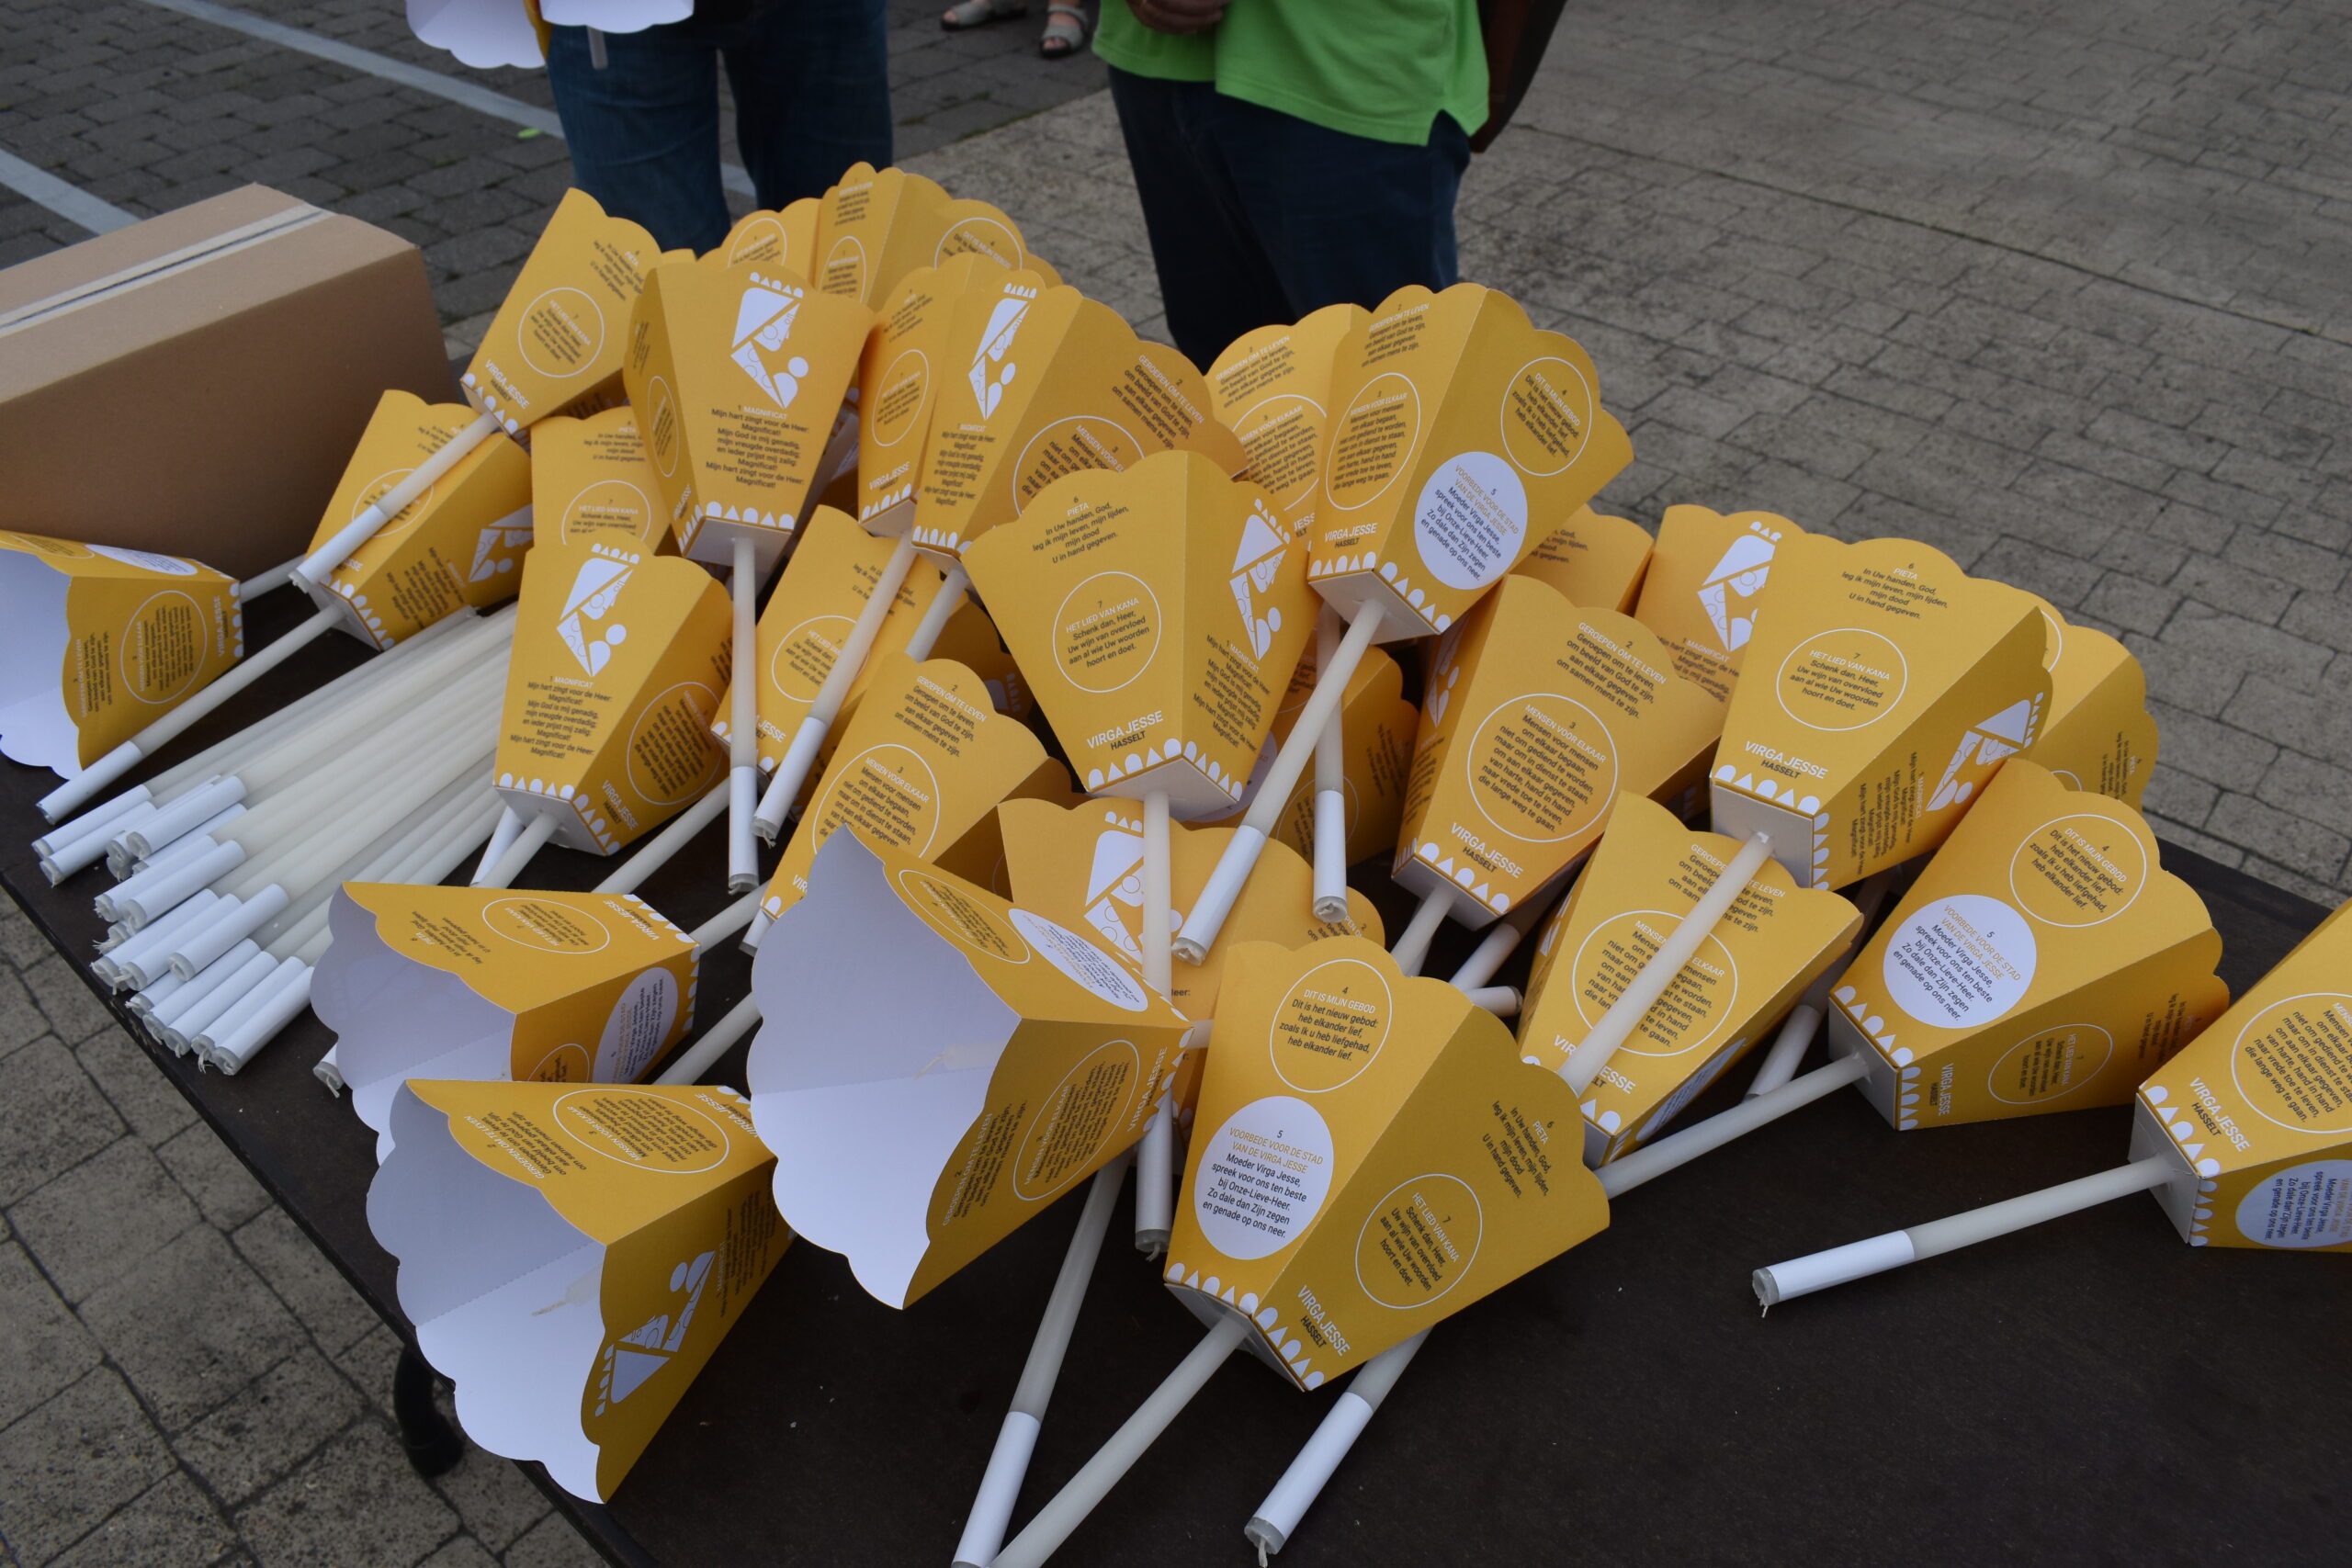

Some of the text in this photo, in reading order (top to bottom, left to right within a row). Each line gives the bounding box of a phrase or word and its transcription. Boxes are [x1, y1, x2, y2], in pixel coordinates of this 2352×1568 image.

[1325, 523, 1375, 540] VIRGA JESSE
[1841, 571, 1854, 581] leg
[1863, 579, 1881, 587] mijn
[1905, 592, 1923, 600] mijn
[1872, 570, 1885, 579] Uw
[1894, 568, 1917, 579] PIETA
[1865, 597, 1885, 607] hand
[1870, 590, 1909, 604] mijn dood
[1066, 598, 1138, 631] HET LIED VAN KANA
[1068, 615, 1145, 653] Uw wijn van overvloed
[1069, 626, 1148, 664] aan al wie Uw woorden
[1073, 625, 1099, 639] Schenk
[1625, 640, 1633, 649] 2
[1086, 654, 1105, 667] hoort
[1577, 633, 1653, 690] Geroepen om te leven,
[1578, 622, 1665, 682] GEROEPEN OM TE LEVEN
[1566, 640, 1653, 703] om beeld van God te zijn,
[1569, 655, 1637, 704] aan elkaar gegeven
[1556, 659, 1638, 717] om samen mens te zijn.
[1087, 710, 1162, 748] VIRGA JESSE
[1110, 730, 1145, 750] HASSELT
[1746, 741, 1826, 778] VIRGA JESSE
[1760, 760, 1800, 778] HASSELT
[1452, 823, 1521, 876] VIRGA JESSE
[1463, 846, 1497, 872] HASSELT
[1916, 925, 1992, 1001] spreek voor ons ten beste
[1931, 924, 1992, 987] Moeder Virga Jesse,
[1292, 998, 1377, 1027] Dit is het nieuw gebod:
[1304, 989, 1374, 1012] DIT IS MIJN GEBOD
[1279, 1022, 1299, 1032] zoals
[1300, 1026, 1308, 1035] ik
[1316, 1030, 1330, 1041] heb
[1331, 1034, 1369, 1053] liefgehad,
[1298, 1012, 1363, 1038] heb elkander lief,
[1287, 1035, 1351, 1060] heb elkander lief.
[2190, 1077, 2250, 1151] VIRGA JESSE
[2191, 1102, 2221, 1134] HASSELT
[1229, 1127, 1322, 1164] VOORBEDE VOOR DE STAD
[1277, 1130, 1283, 1138] 5
[1226, 1153, 1299, 1187] Moeder Virga Jesse,
[1232, 1141, 1307, 1173] VAN DE VIRGA JESSE
[1211, 1163, 1306, 1201] spreek voor ons ten beste
[1217, 1177, 1289, 1210] bij Onze-Lieve-Heer.
[1203, 1201, 1284, 1237] en genade op ons neer.
[1207, 1187, 1289, 1224] Zo dale dan Zijn zegen
[1298, 1285, 1350, 1355] VIRGA JESSE
[1300, 1315, 1326, 1347] HASSELT
